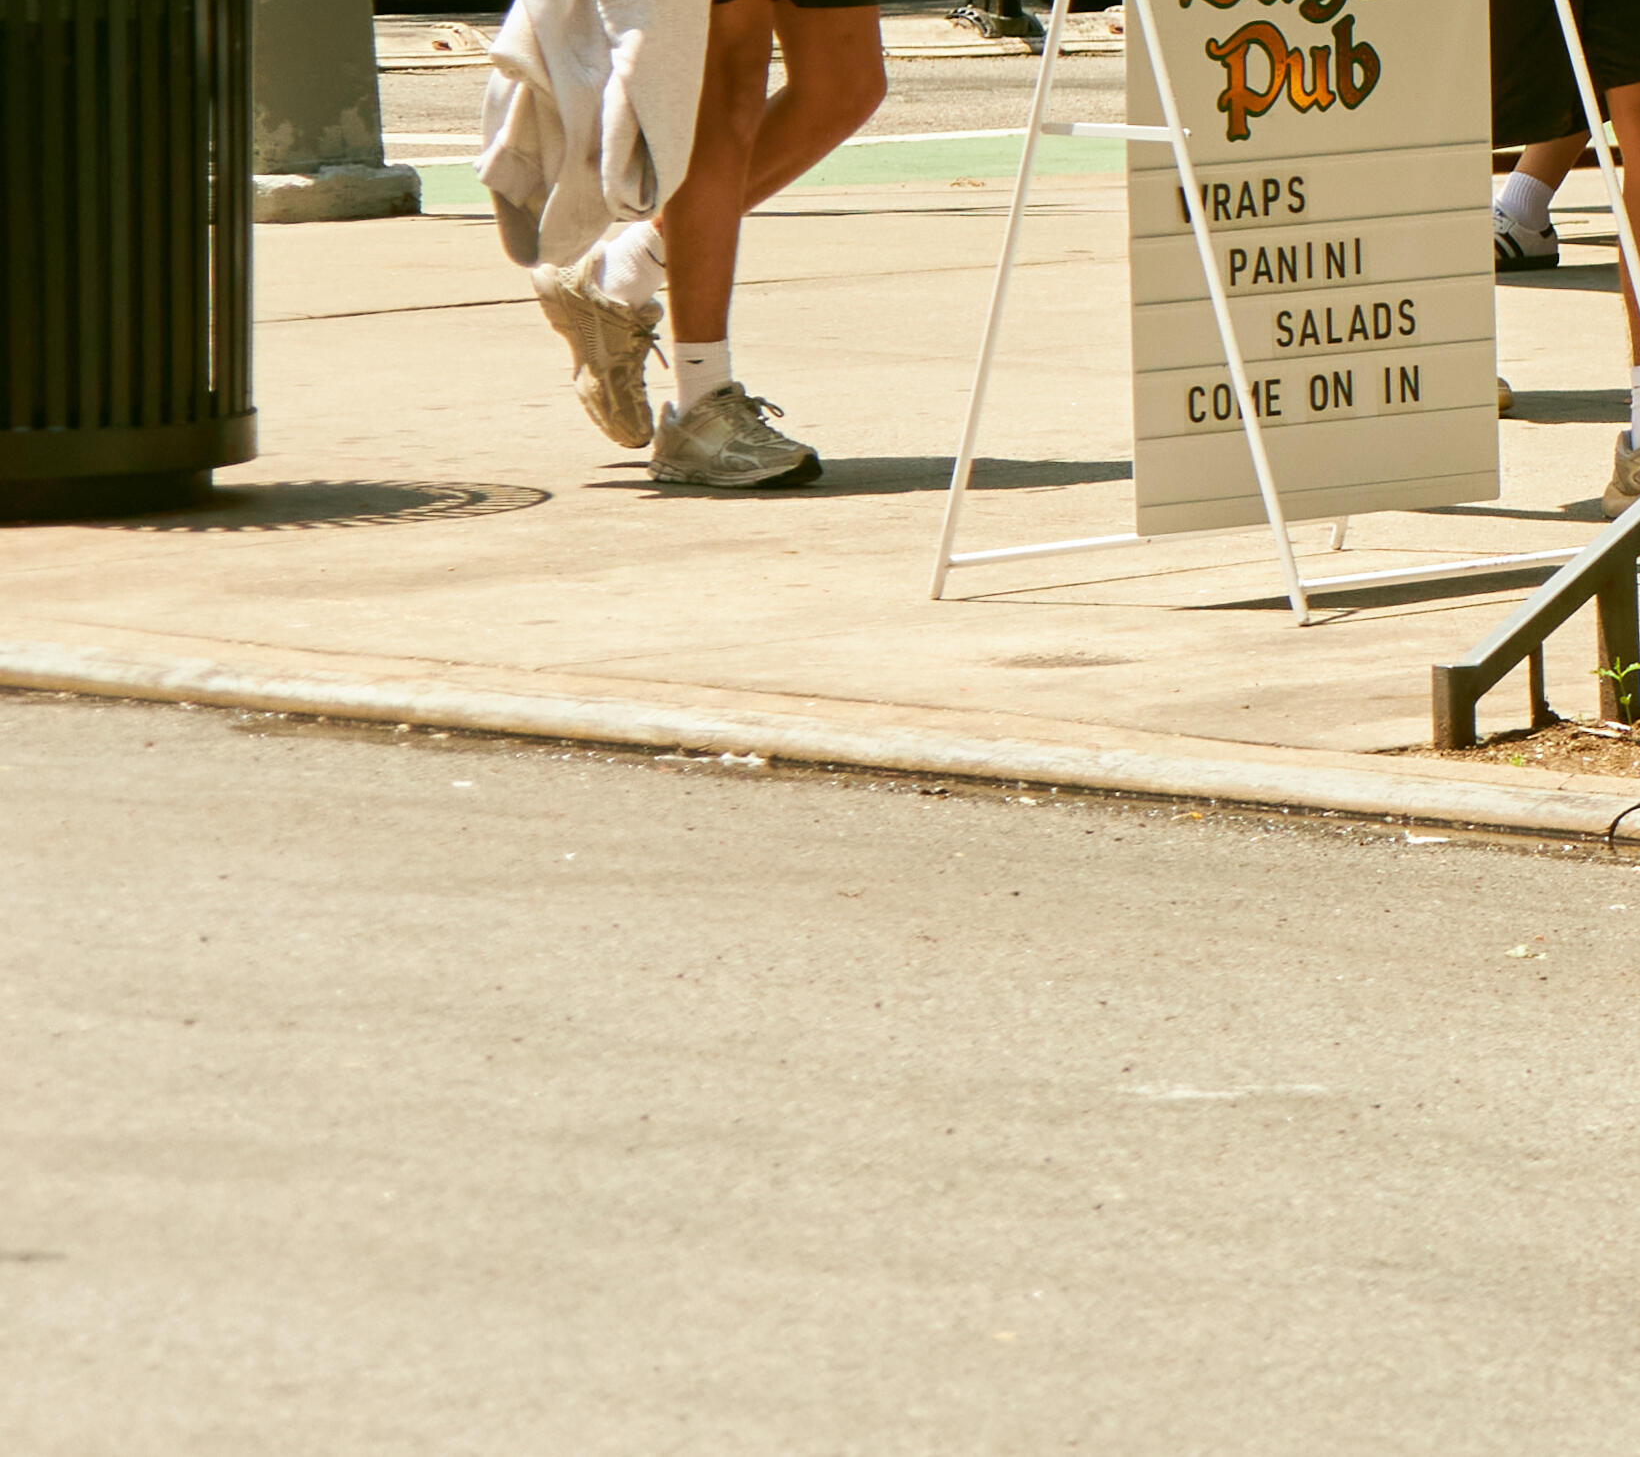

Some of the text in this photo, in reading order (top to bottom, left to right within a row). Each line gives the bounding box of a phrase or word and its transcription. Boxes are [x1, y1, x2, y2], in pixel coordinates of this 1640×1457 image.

[1205, 14, 1381, 142] Pub
[1230, 237, 1363, 287] PANINI
[1276, 298, 1417, 348] SALADS
[1309, 369, 1353, 411] ON
[1385, 365, 1420, 404] IN
